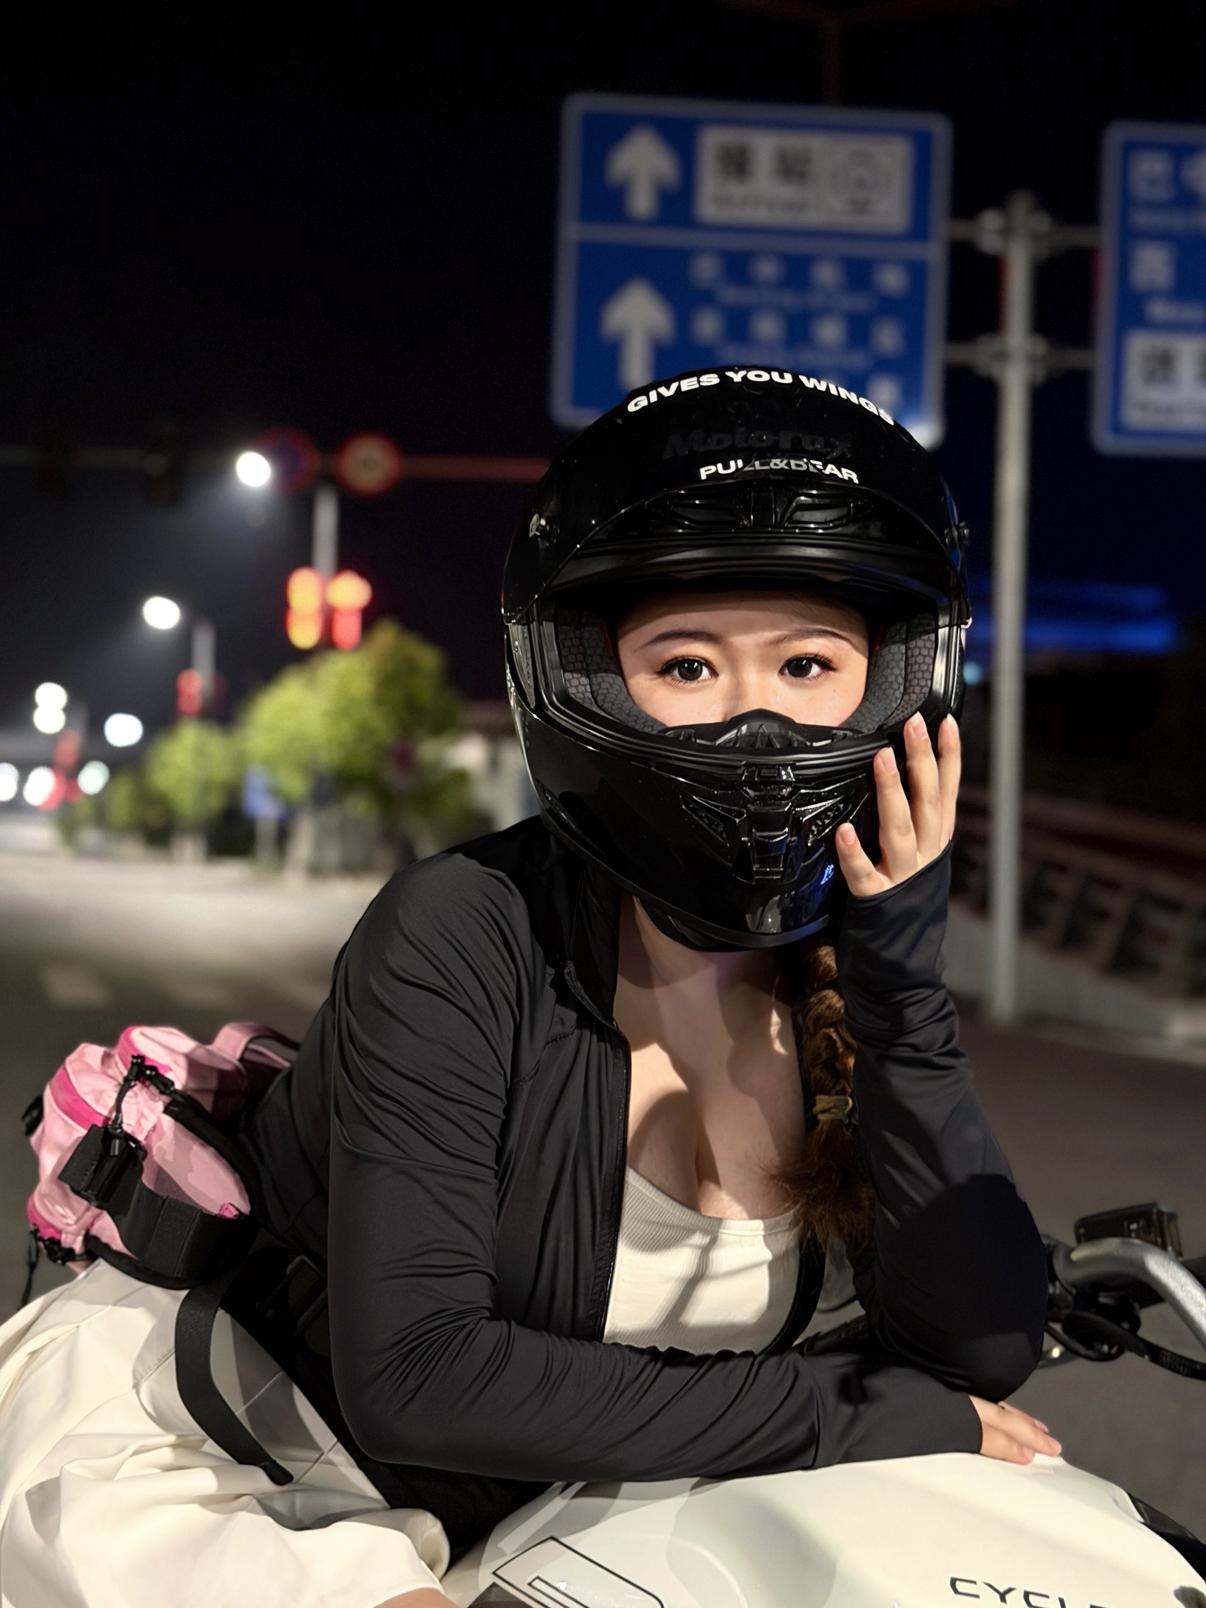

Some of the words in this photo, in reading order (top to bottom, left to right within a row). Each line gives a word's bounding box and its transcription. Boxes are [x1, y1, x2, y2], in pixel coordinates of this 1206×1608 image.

[627, 373, 720, 412] GIVES
[725, 370, 793, 384] YOU
[799, 375, 894, 425] WINGS
[949, 1576, 1107, 1608] CYC
